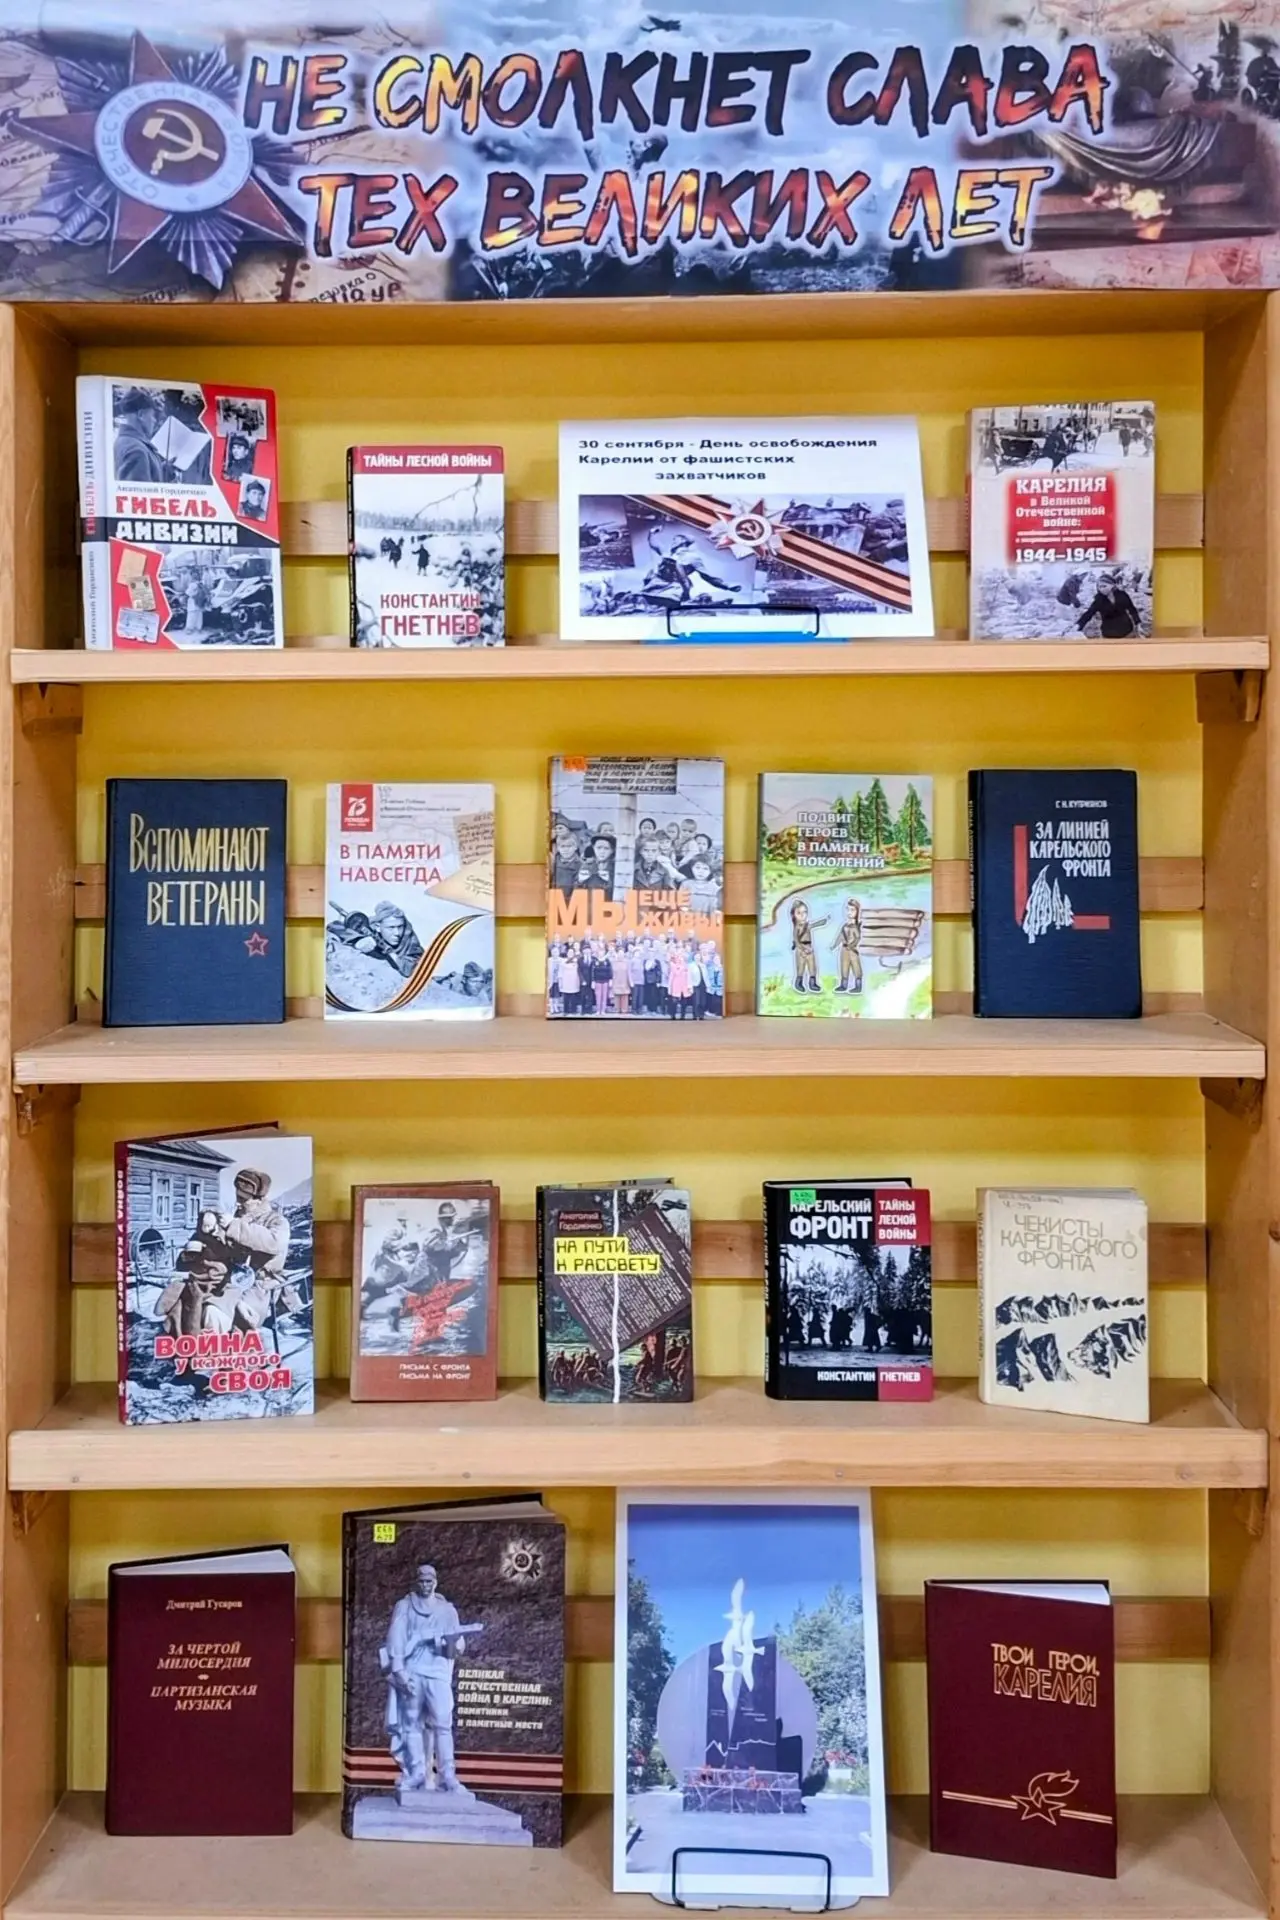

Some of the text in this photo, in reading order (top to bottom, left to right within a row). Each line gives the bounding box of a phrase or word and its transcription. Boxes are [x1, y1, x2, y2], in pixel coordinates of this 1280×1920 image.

[243, 43, 1110, 139] НЕ СМОЛКНЕТ СЛАВА
[299, 166, 1053, 256] ТЕХ ВЕЛИКИХ ЛЕТ
[578, 440, 599, 449] 30
[604, 439, 684, 450] сентября
[699, 439, 743, 450] День
[748, 438, 878, 449] освобождения
[363, 453, 492, 467] ТАЙНЫ ЛЕСНОЙ ВОЙНЫ
[578, 454, 796, 466] Карелии от фашистских
[83, 411, 97, 535] ГИБЕЛЬ ДИВИЗИИ
[654, 472, 767, 481] захватчиков
[1016, 477, 1107, 494] КАРЕЛИЯ
[115, 495, 218, 518] ГИБЕЛЬ
[1041, 495, 1091, 506] Великой
[1015, 505, 1106, 517] Отечественной
[1043, 516, 1081, 527] войне:
[115, 521, 238, 544] ДИВИЗИИ
[380, 593, 481, 609] КОНСТАНТИН
[380, 614, 481, 636] ГНЕТНЕВ
[797, 812, 855, 823] ПОДВИГ
[797, 827, 848, 838] ГЕРОЕВ
[1035, 819, 1109, 839] ЗА ЛИНИЕЙ
[340, 844, 441, 860] В ПАМЯТИ
[798, 841, 870, 853] В ПАМЯТИ
[1029, 840, 1111, 858] КАРЕЛЬСКОГО
[797, 855, 885, 868] ПОКОЛЕНИЙ
[1062, 859, 1111, 877] ФРОНТА
[340, 867, 442, 885] НАВСЕГДА
[146, 880, 265, 926] ВЕТЕРАНЫ
[548, 888, 637, 927] МЫ
[639, 911, 723, 928] ЖИВЫ
[879, 1199, 915, 1211] ТАЙНЫ
[559, 1212, 602, 1231] Анатолий Гордиенко
[878, 1213, 916, 1225] ЛЕСНОЙ
[1014, 1214, 1103, 1239] ЧЕКИСТЫ
[789, 1216, 873, 1239] ФРОНТ
[879, 1228, 916, 1239] ВОЙНЫ
[556, 1239, 626, 1254] НА ПУТИ
[1001, 1230, 1138, 1259] КАРЕЛЬСКОГО
[574, 1258, 658, 1272] РАССВЕТУ
[1017, 1250, 1095, 1272] ФРОНТА
[154, 1330, 263, 1359] ВОЙНА
[191, 1353, 280, 1371] каждого
[209, 1368, 292, 1392] СВОЯ
[817, 1371, 920, 1382] КОНСТАНТИН ГНЕТНЕВ
[166, 1599, 242, 1611] Дмитрий Гусаров
[168, 1641, 241, 1655] ЗА ЧЕРТОЙ
[157, 1657, 252, 1671] МИЛОСЕРДИЯ
[991, 1643, 1100, 1676] ТВОИ ГЕРОИ,
[458, 1669, 505, 1679] ВЕЛИКАЯ
[150, 1685, 258, 1698] ПАРТИЗАНСКАЯ
[458, 1681, 542, 1693] ОТЕЧЕСТВЕННАЯ
[993, 1664, 1098, 1708] КАРЕЛИЯ
[174, 1699, 233, 1711] МУЗЫКА
[458, 1692, 491, 1704] ВОЙНА
